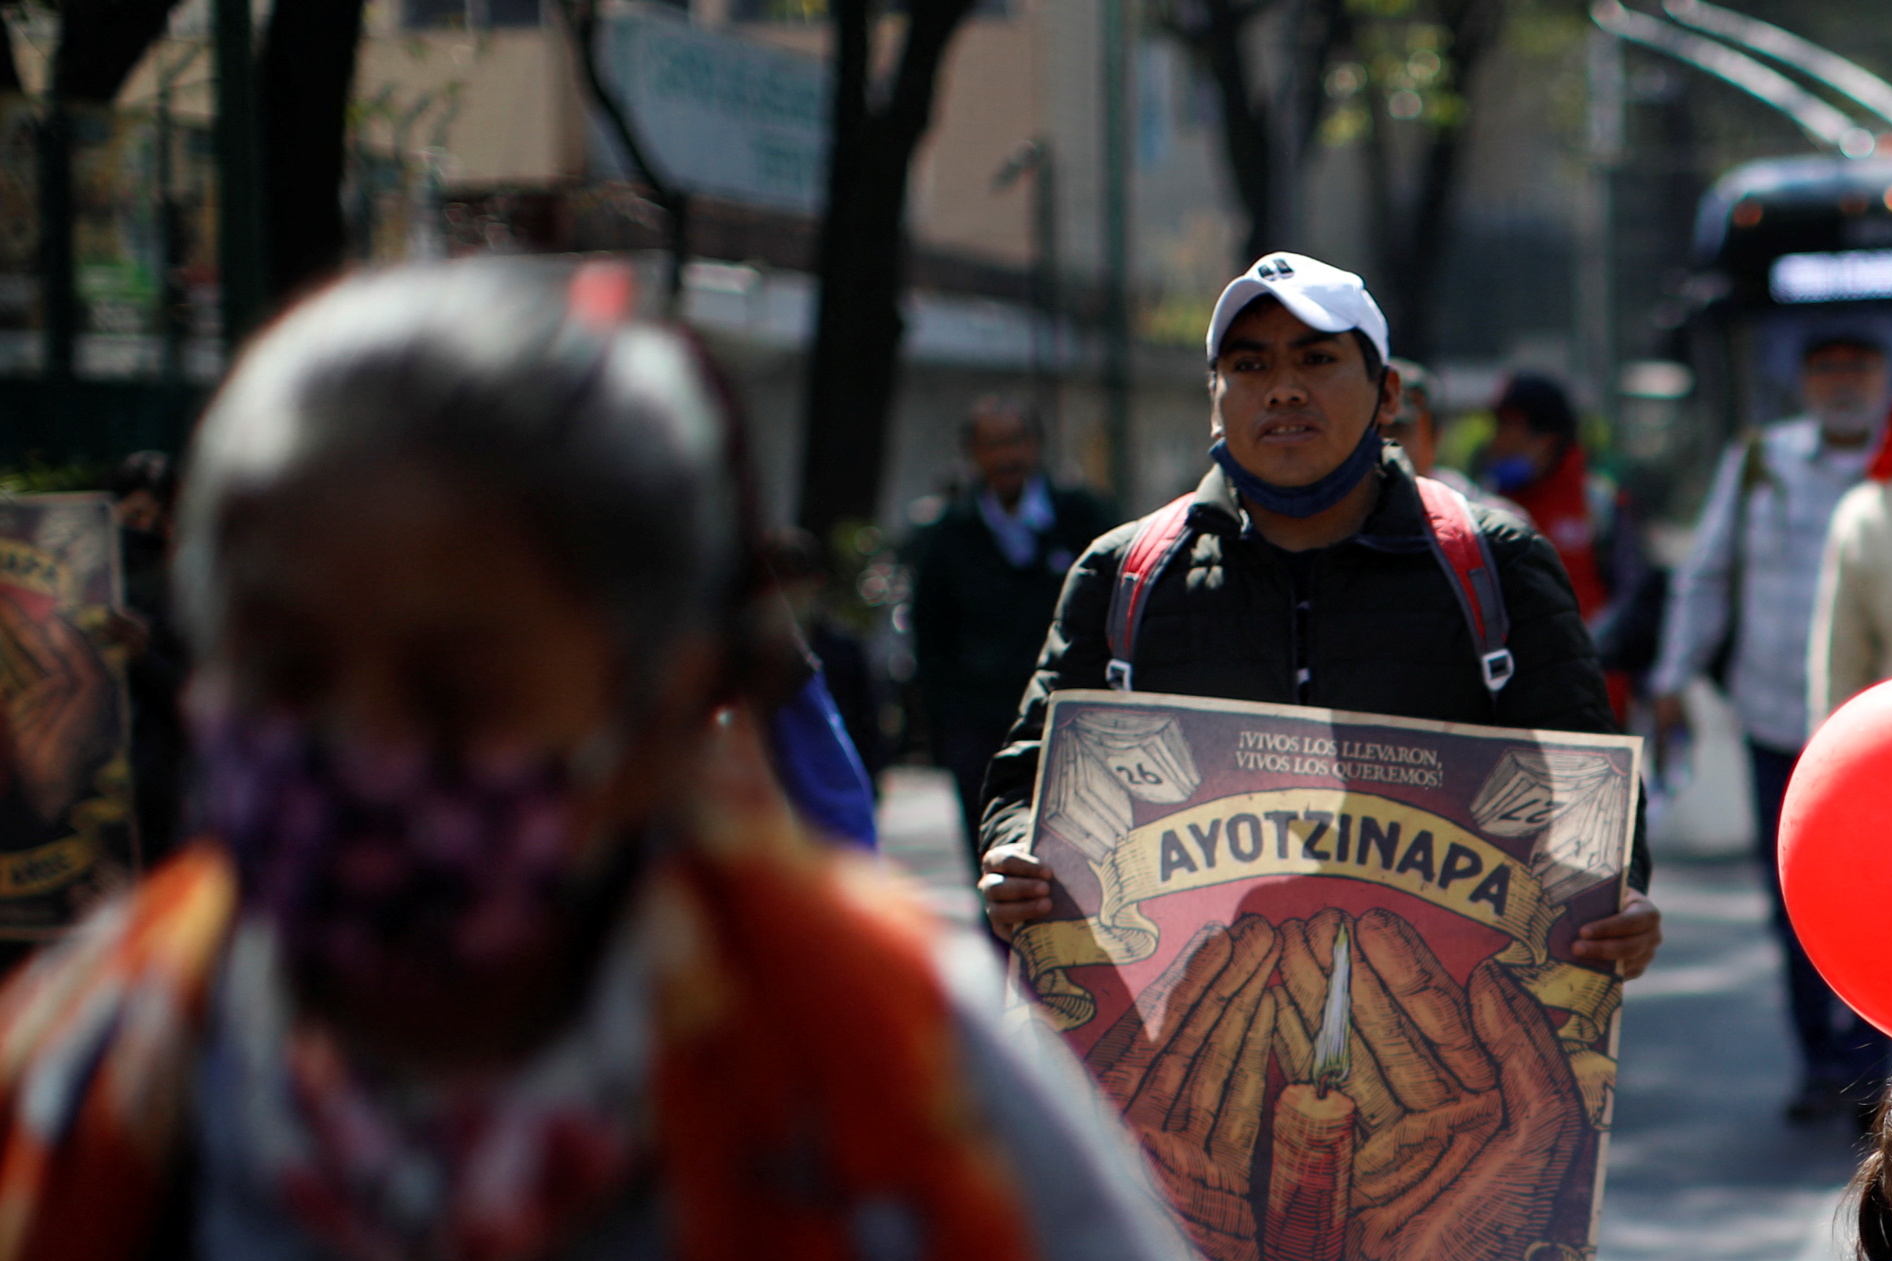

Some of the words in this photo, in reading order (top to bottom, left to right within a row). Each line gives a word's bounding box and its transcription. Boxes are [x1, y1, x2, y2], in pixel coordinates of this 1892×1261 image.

[1239, 731, 1299, 751] ¡VIVOS
[1302, 737, 1338, 756] LOS
[1341, 741, 1442, 769] LLEVARON,
[1115, 762, 1163, 785] 26
[1235, 751, 1290, 771] VIVOS
[1292, 757, 1329, 776] LOS
[1331, 762, 1443, 788] QUEREMOS!
[1157, 810, 1513, 917] AYOTZINAPA
